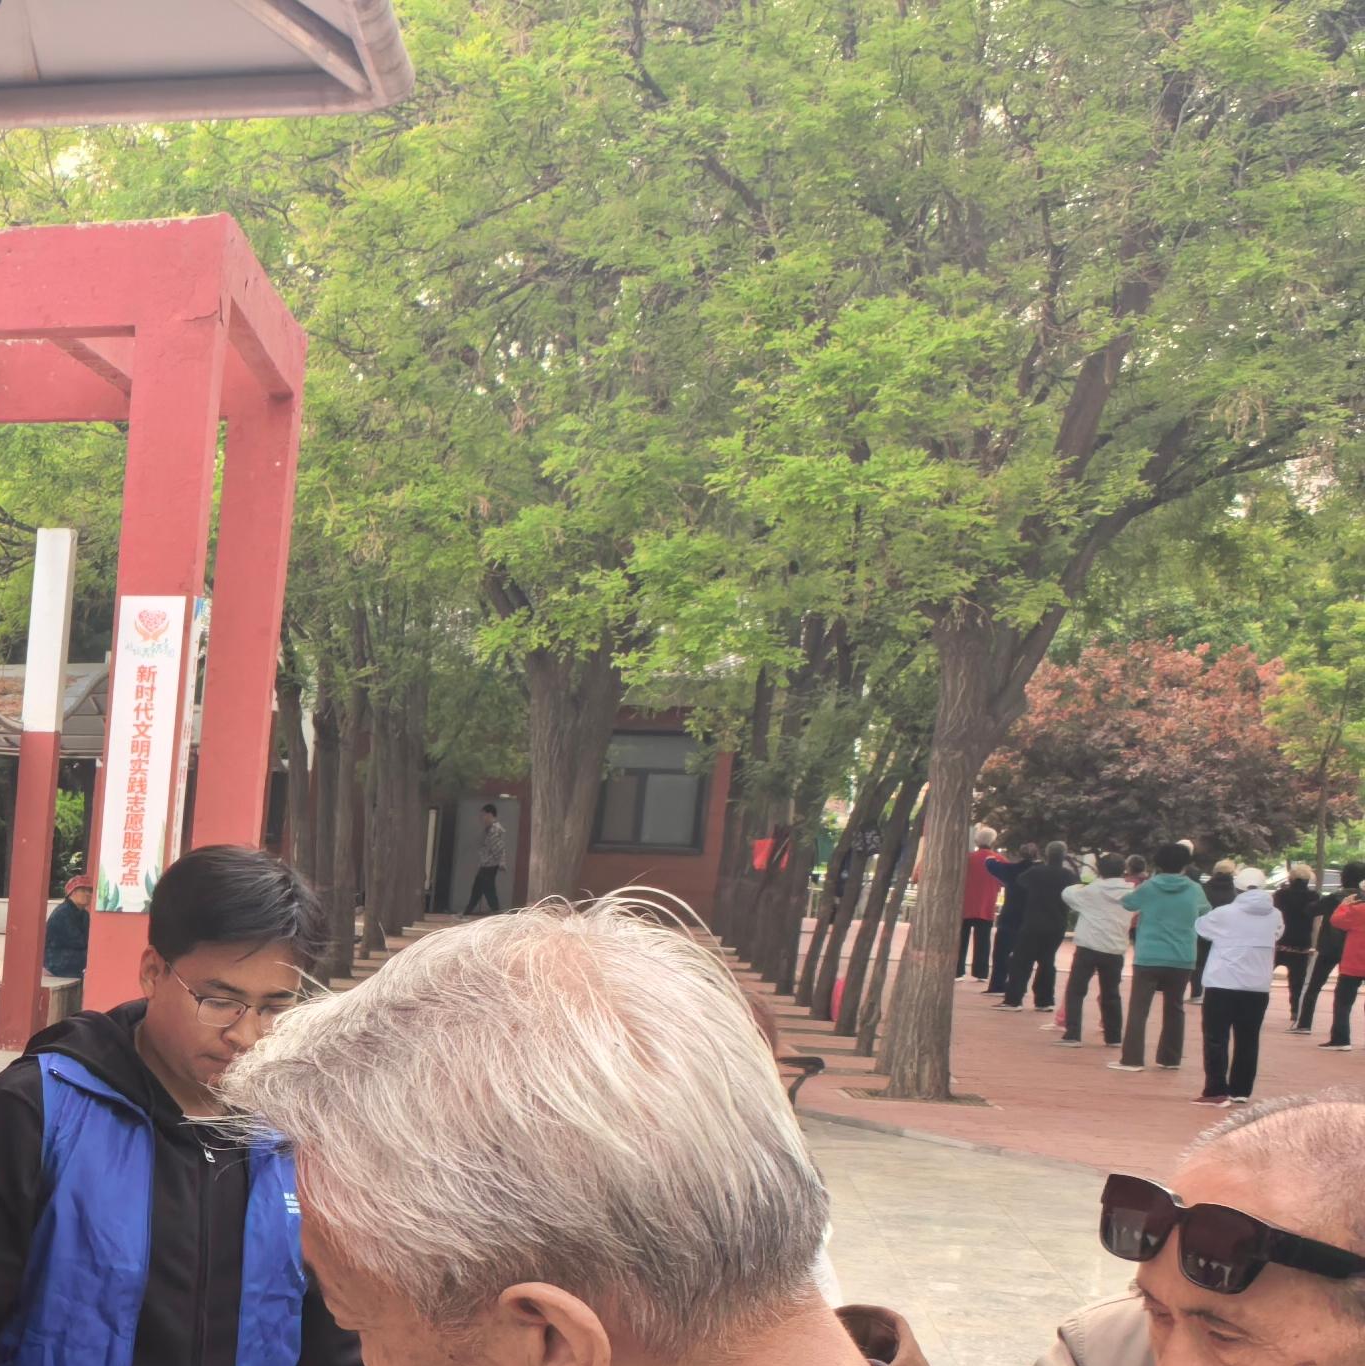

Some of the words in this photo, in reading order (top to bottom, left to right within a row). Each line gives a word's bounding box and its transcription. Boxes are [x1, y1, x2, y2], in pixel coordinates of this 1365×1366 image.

[119, 664, 158, 887] 新时代文明实践志愿服务点
